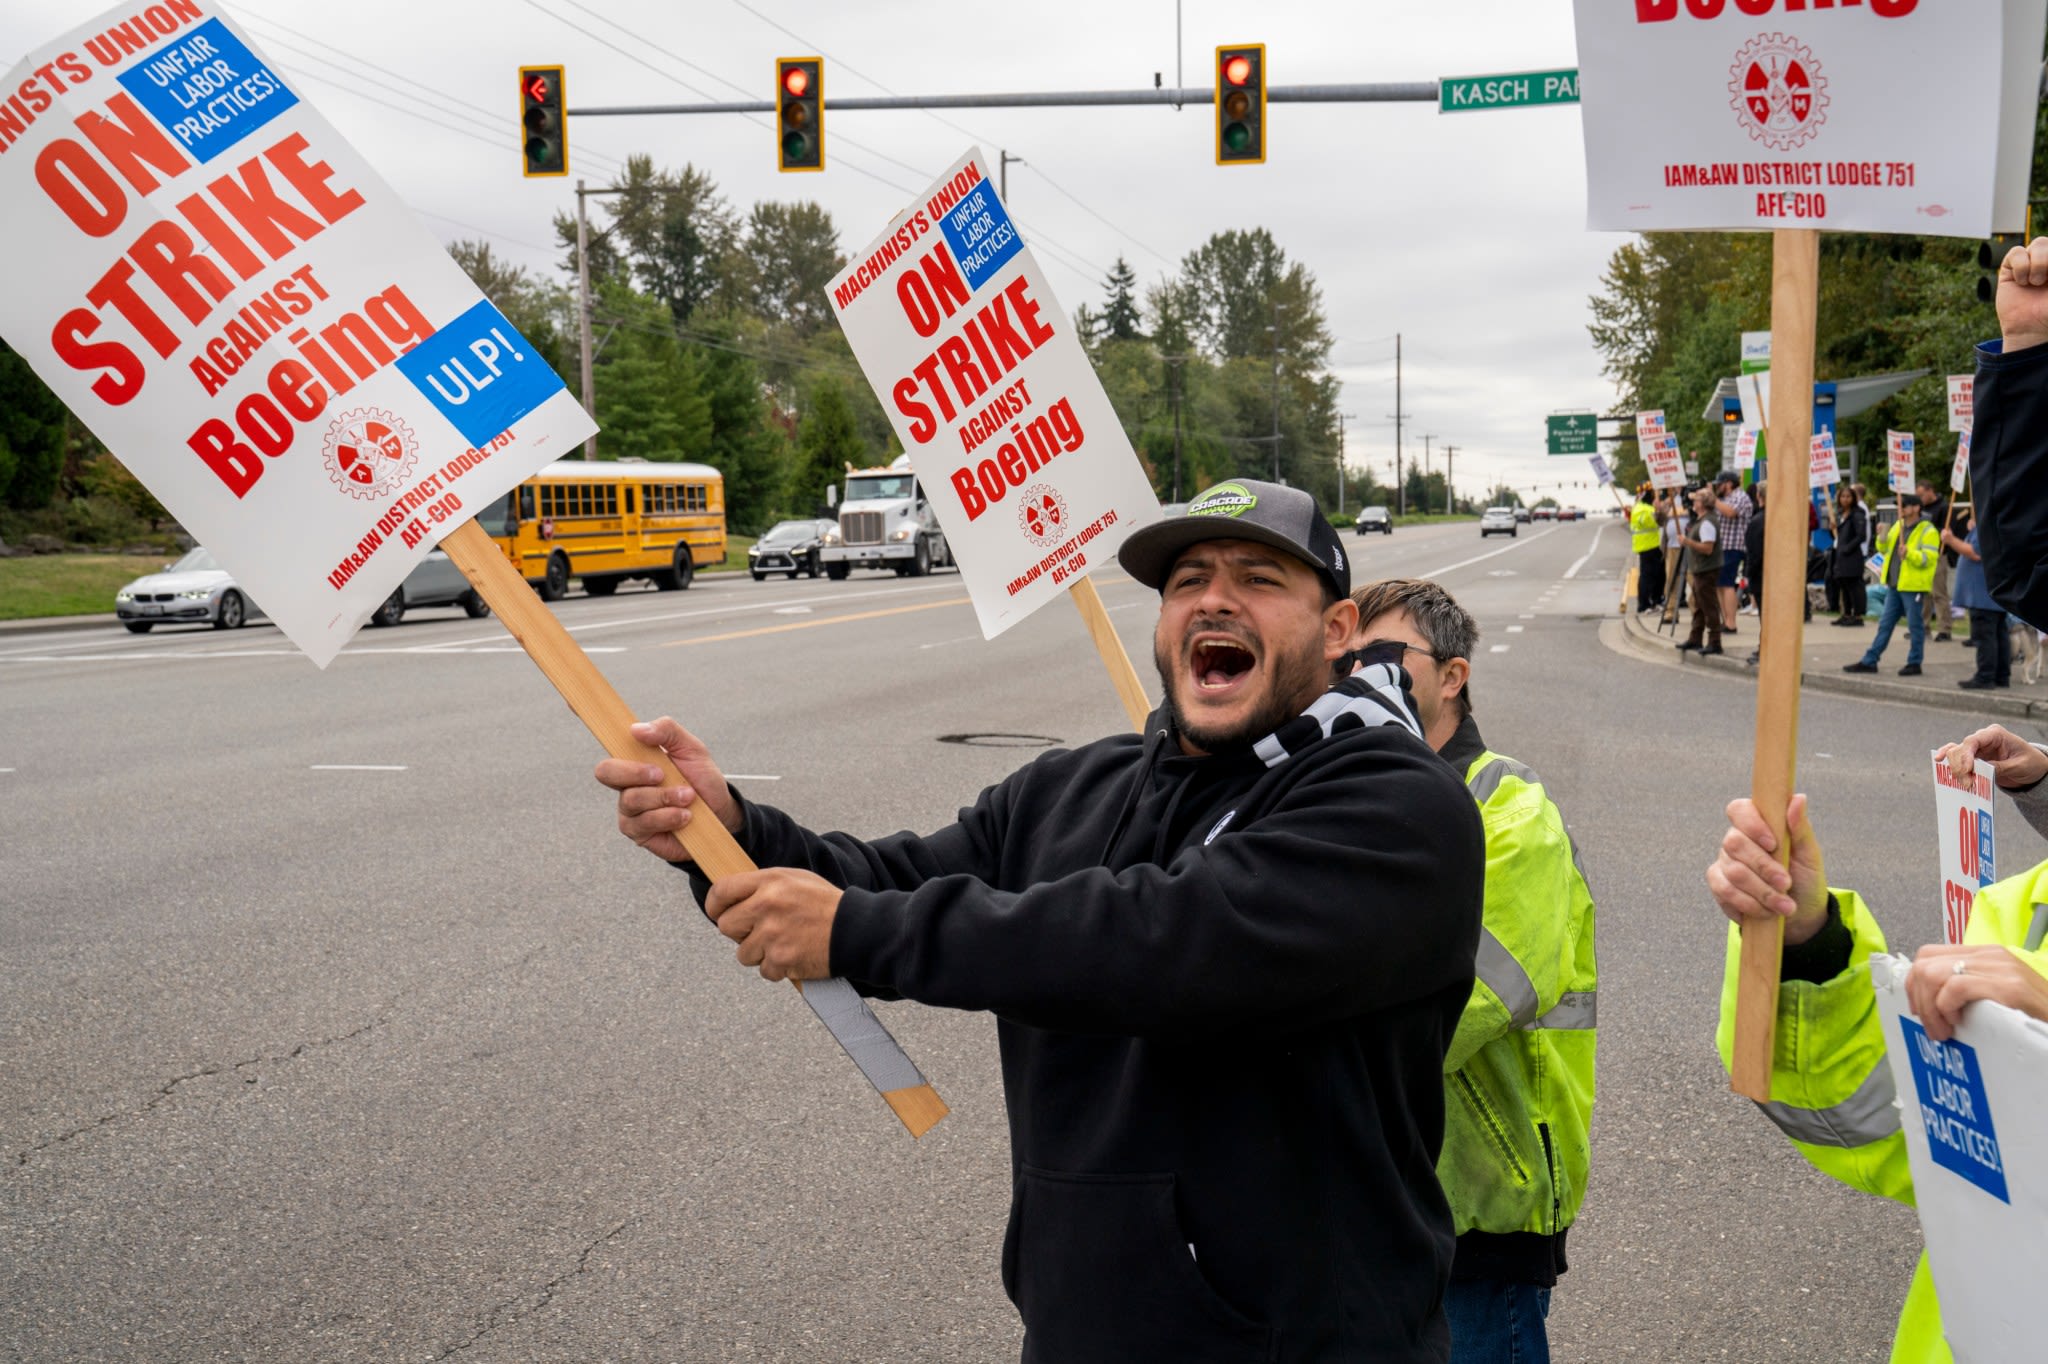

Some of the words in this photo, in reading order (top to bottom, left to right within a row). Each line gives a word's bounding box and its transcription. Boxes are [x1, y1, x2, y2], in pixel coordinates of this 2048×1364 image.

[0, 52, 93, 154] NISTS
[83, 0, 203, 67] UNION
[144, 35, 219, 88] UNFAIR
[169, 59, 239, 110] LABOR
[1452, 79, 1529, 105] KASCH
[173, 69, 281, 146] PRACTICES!
[35, 91, 192, 238] ON
[1664, 163, 1738, 187] IAM&AW
[1743, 162, 1822, 186] DISTRICT
[1828, 162, 1881, 186] LODGE
[1885, 162, 1915, 187] 751
[833, 210, 930, 310] MACHINISTS
[926, 160, 981, 222] UNION
[951, 191, 987, 232] UNFAIR
[961, 211, 996, 249] LABOR
[1756, 192, 1826, 218] AFL-CIO
[51, 131, 367, 406] STRIKE
[961, 220, 1016, 278] PRACTICES!
[896, 240, 971, 337] ON
[188, 263, 330, 397] AGAINST
[425, 327, 524, 405] ULP!
[892, 274, 1055, 444] STRIKE
[186, 283, 437, 499] Boeing
[958, 377, 1032, 455] AGAINST
[950, 396, 1084, 522] Boeing
[327, 528, 384, 591] IAM&AW
[376, 473, 445, 537] DISTRICT
[439, 448, 492, 484] LODGE
[399, 492, 463, 550] AFL-CIO
[1191, 496, 1252, 512] CASCADE
[1006, 564, 1042, 596] IAM&AW
[1040, 537, 1079, 572] DISTRICT
[1076, 519, 1104, 547] LODGE
[1101, 508, 1119, 528] 751
[1051, 552, 1087, 585] AFL-CIO
[1959, 806, 1979, 880] ON
[1914, 1031, 1970, 1083] UNFAIR
[1927, 1070, 1977, 1123] LABOR
[1920, 1103, 2002, 1174] PRACTICES!
